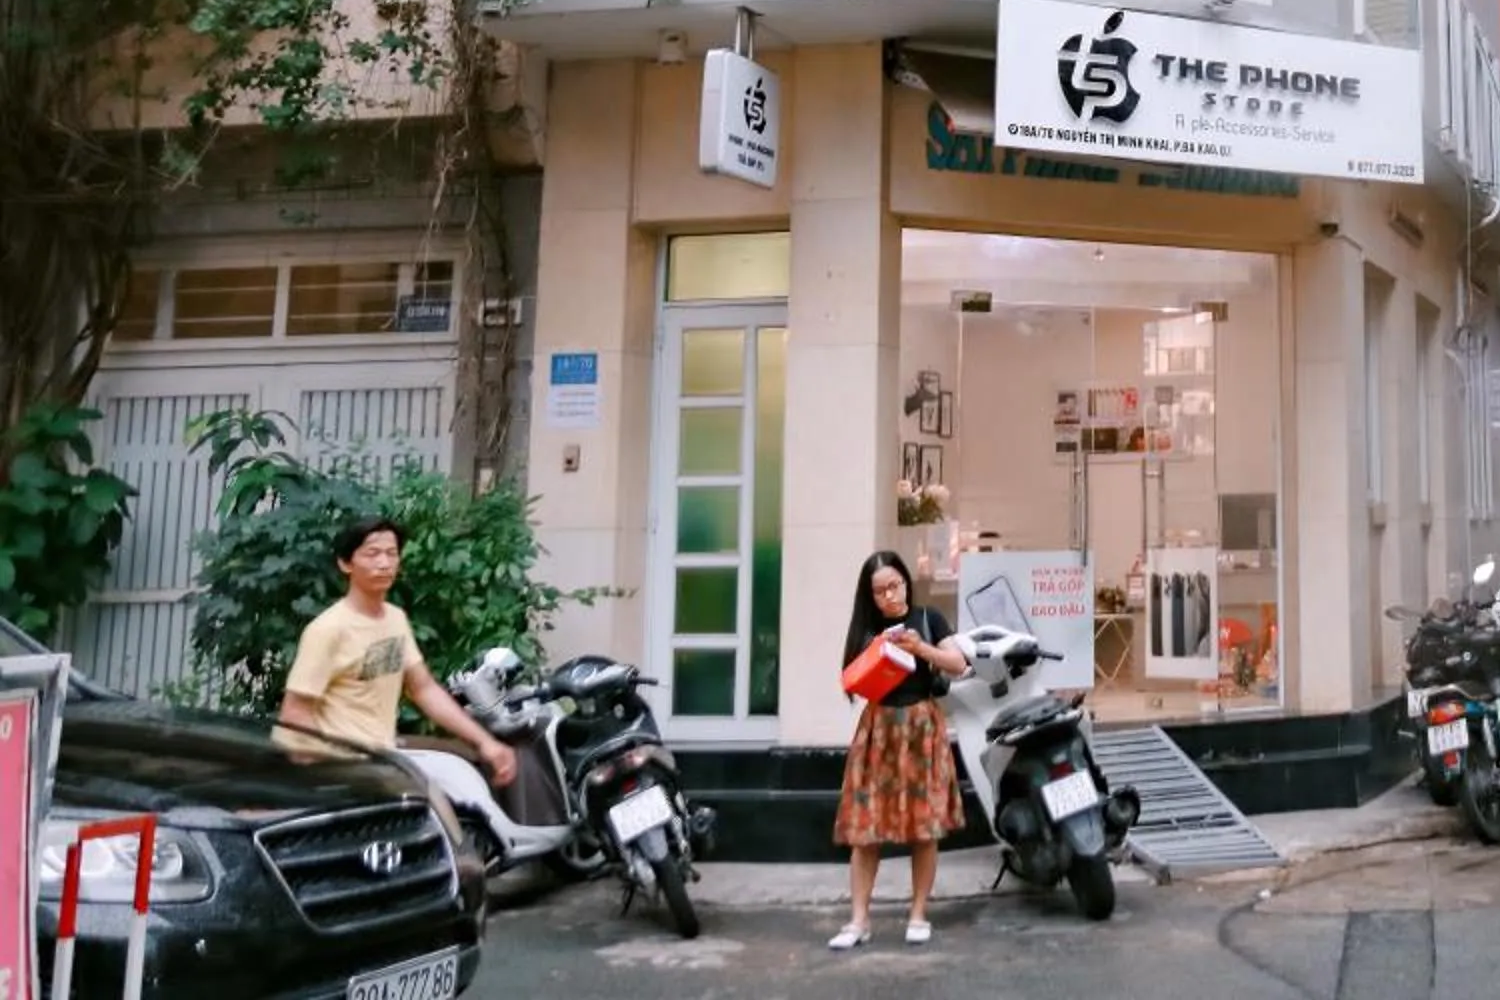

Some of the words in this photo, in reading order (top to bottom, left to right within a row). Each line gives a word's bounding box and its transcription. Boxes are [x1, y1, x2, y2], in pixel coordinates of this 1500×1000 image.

[1155, 54, 1228, 83] THE
[1240, 64, 1361, 99] PHONE
[1202, 92, 1304, 115] STORE
[1117, 135, 1144, 149] MINH
